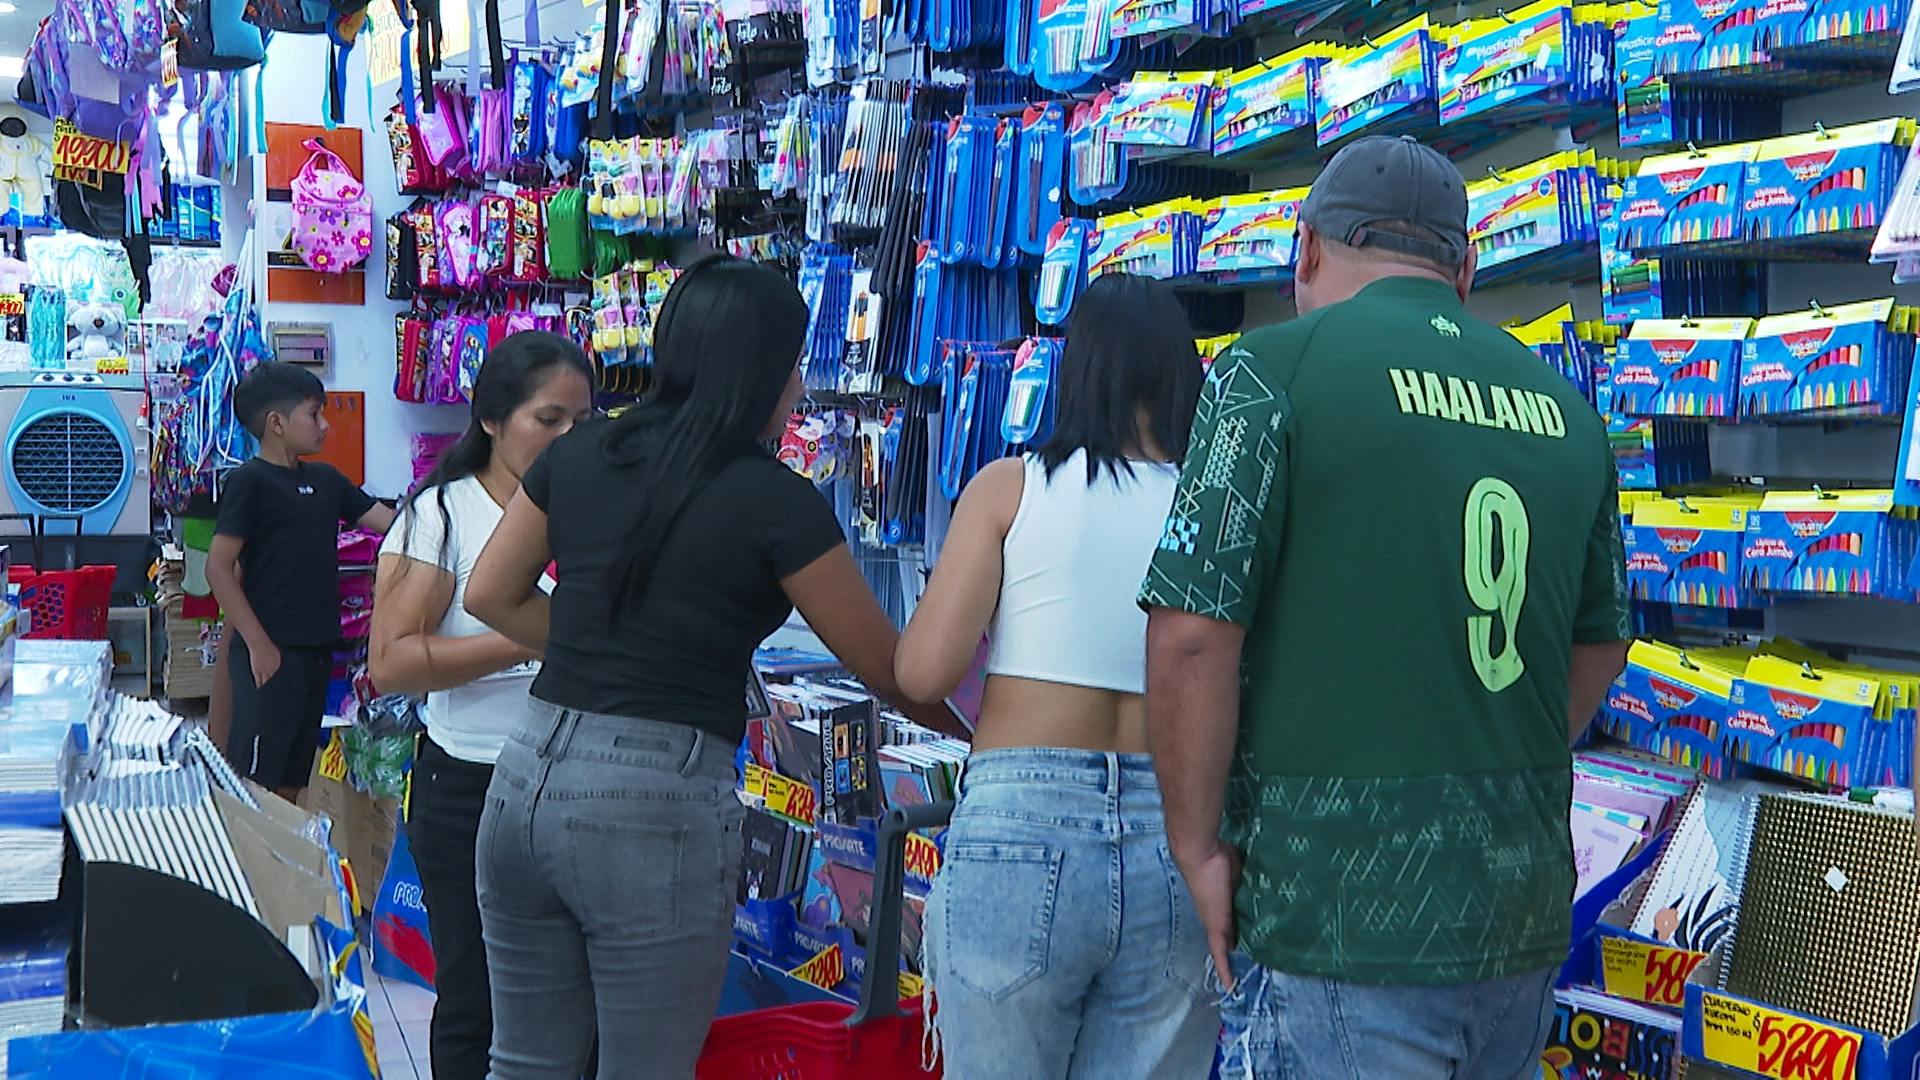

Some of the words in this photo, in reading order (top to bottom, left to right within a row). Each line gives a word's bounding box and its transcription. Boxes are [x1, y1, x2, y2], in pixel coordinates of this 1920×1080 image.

[1389, 368, 1567, 438] HAALAND
[1464, 476, 1531, 692] 9
[1704, 995, 1750, 1016] CUADERNO
